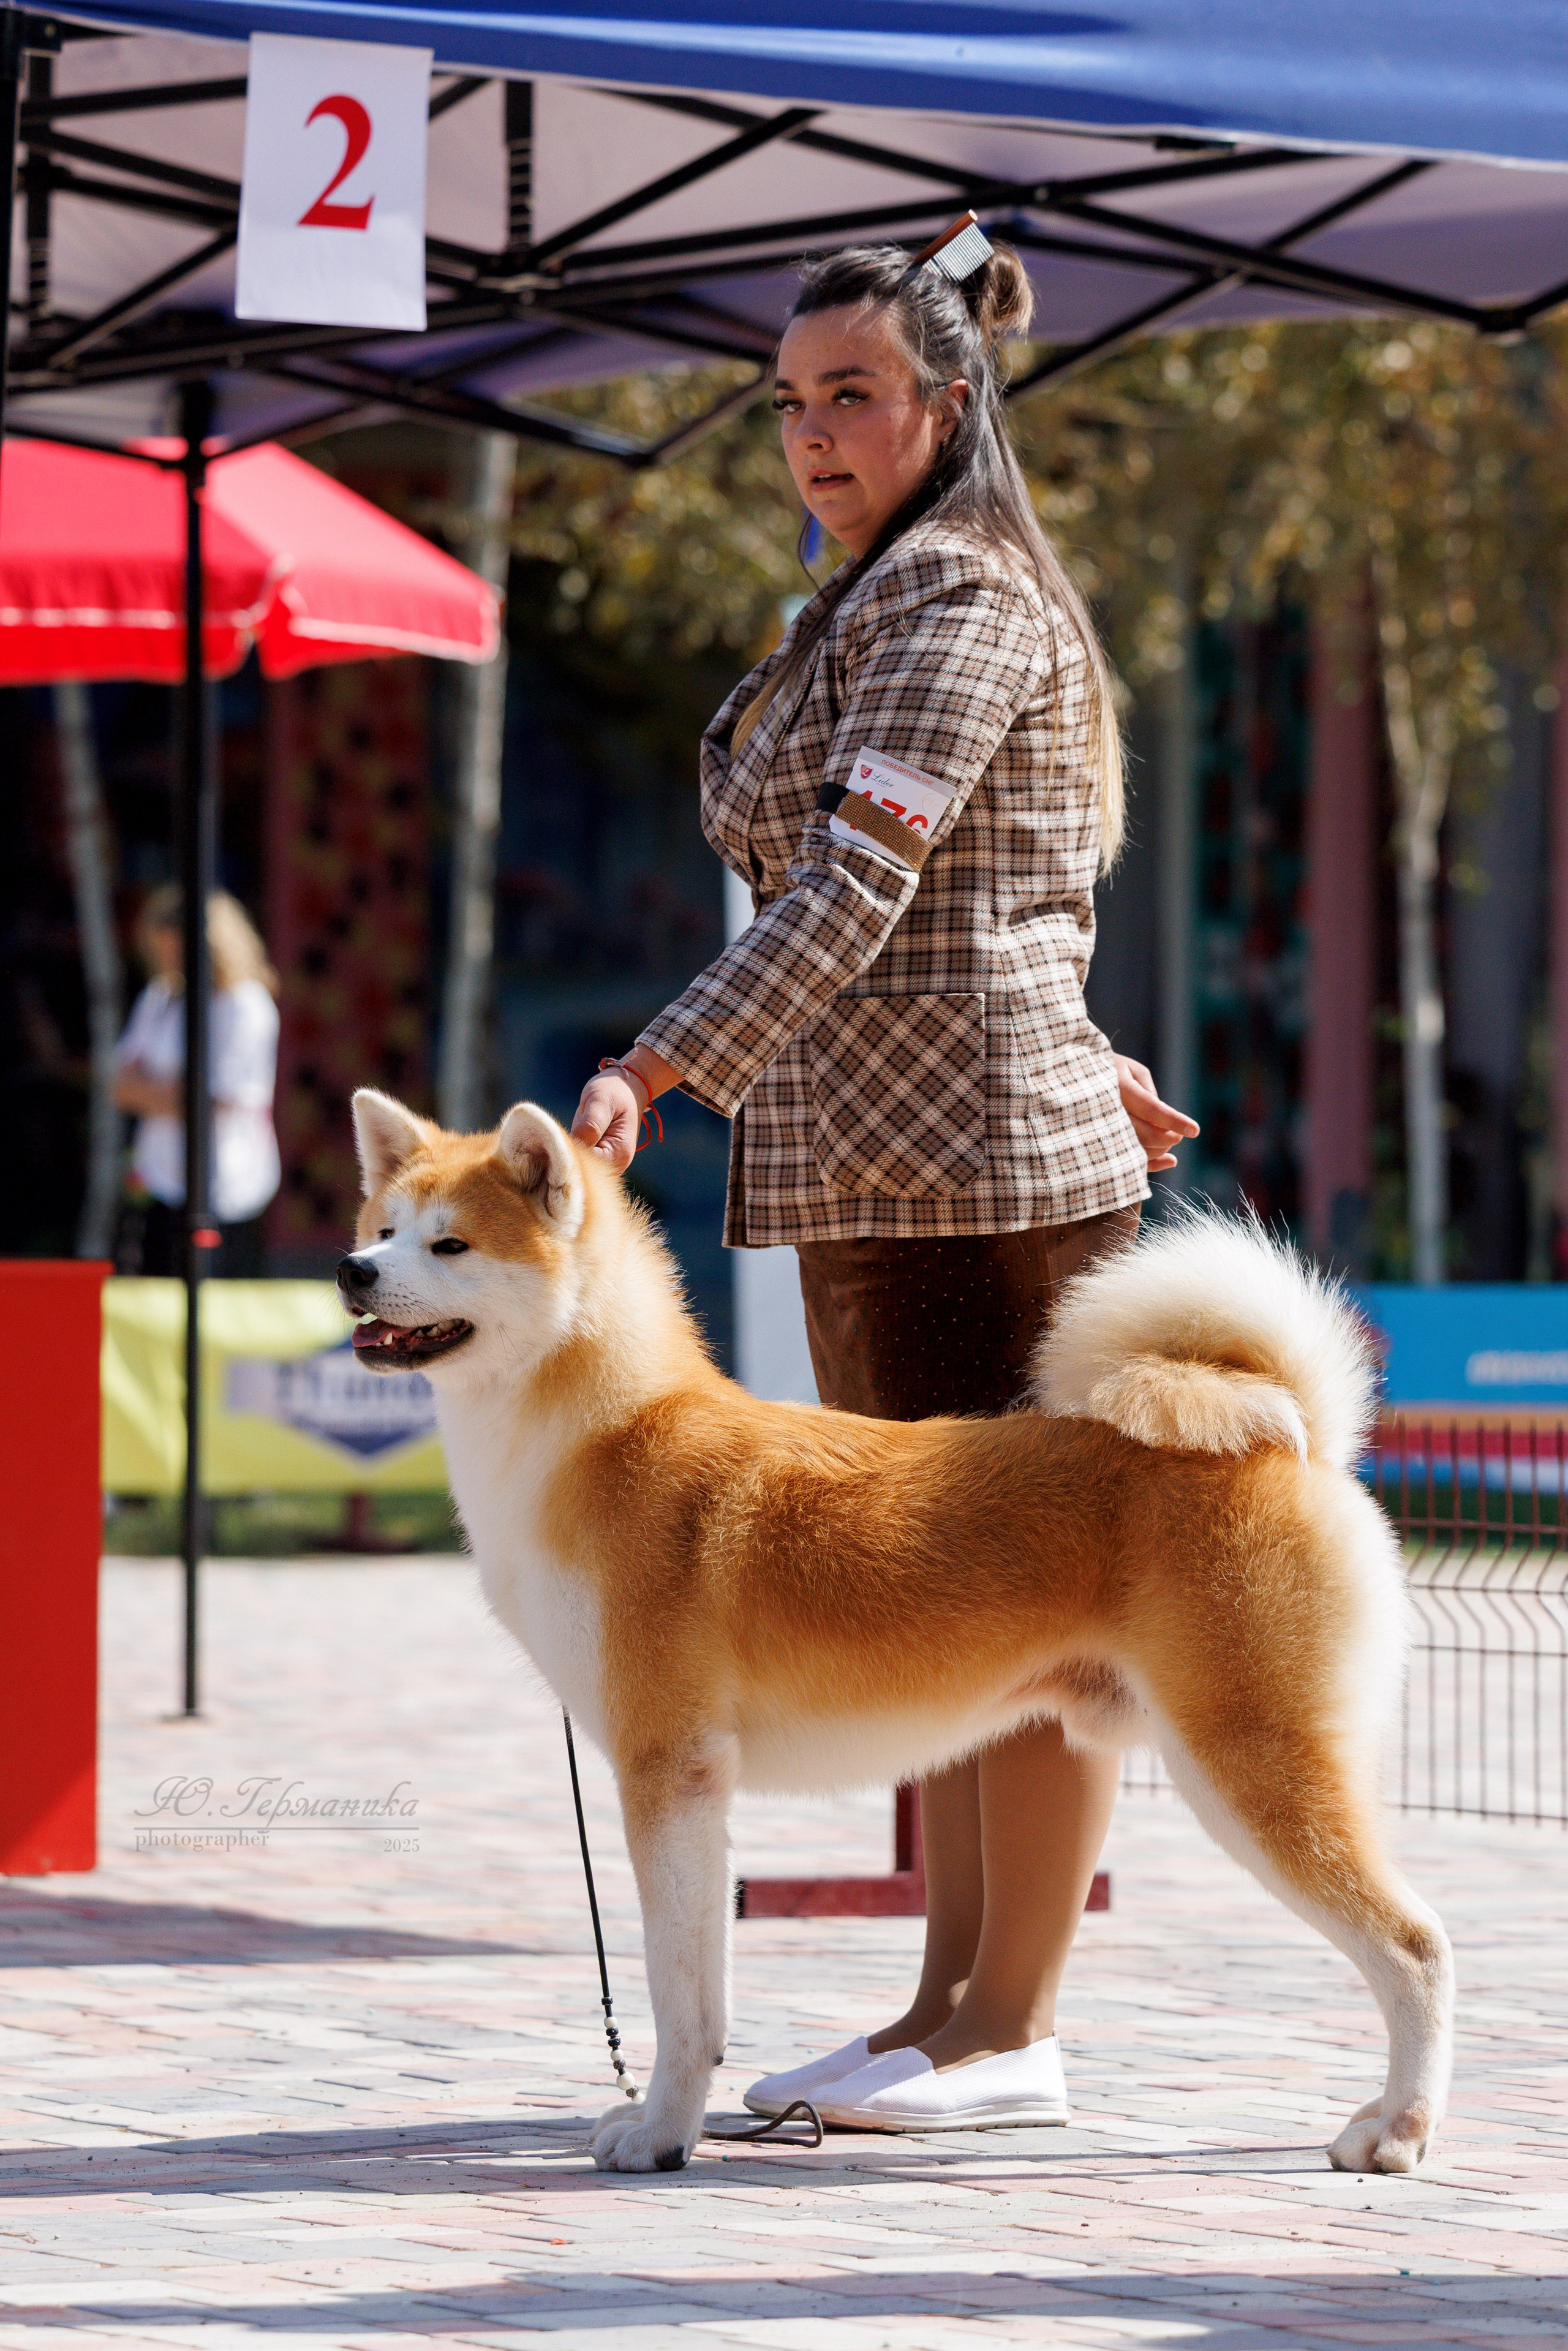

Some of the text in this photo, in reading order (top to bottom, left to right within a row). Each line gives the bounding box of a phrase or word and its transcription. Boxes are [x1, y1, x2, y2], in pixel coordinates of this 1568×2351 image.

[297, 94, 375, 232] 2
[881, 759, 934, 786] ПОБЕДИТЕЛЬ СНГ
